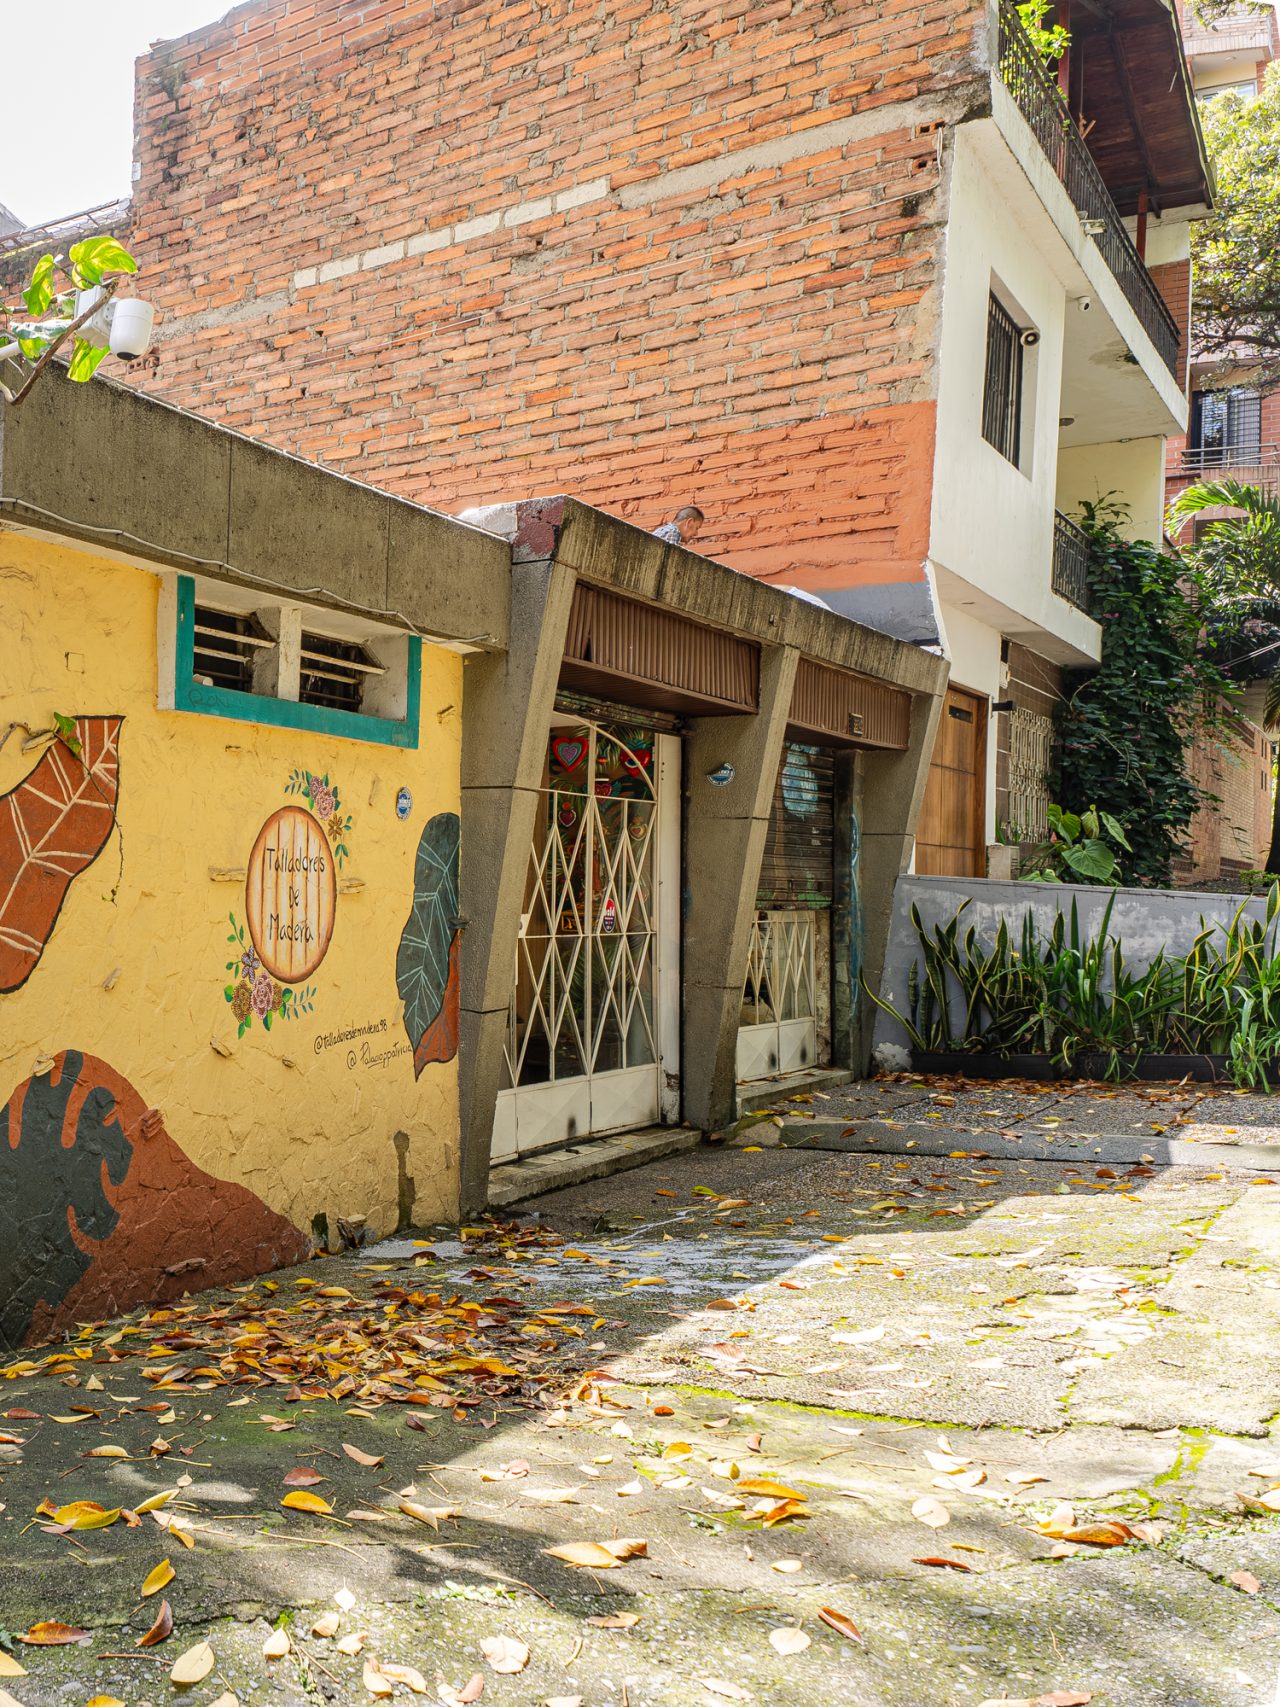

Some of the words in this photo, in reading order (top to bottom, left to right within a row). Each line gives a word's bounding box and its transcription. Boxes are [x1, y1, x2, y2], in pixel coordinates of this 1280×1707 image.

[266, 847, 325, 872] Talladores
[289, 886, 300, 909] De
[269, 912, 314, 943] Madera
